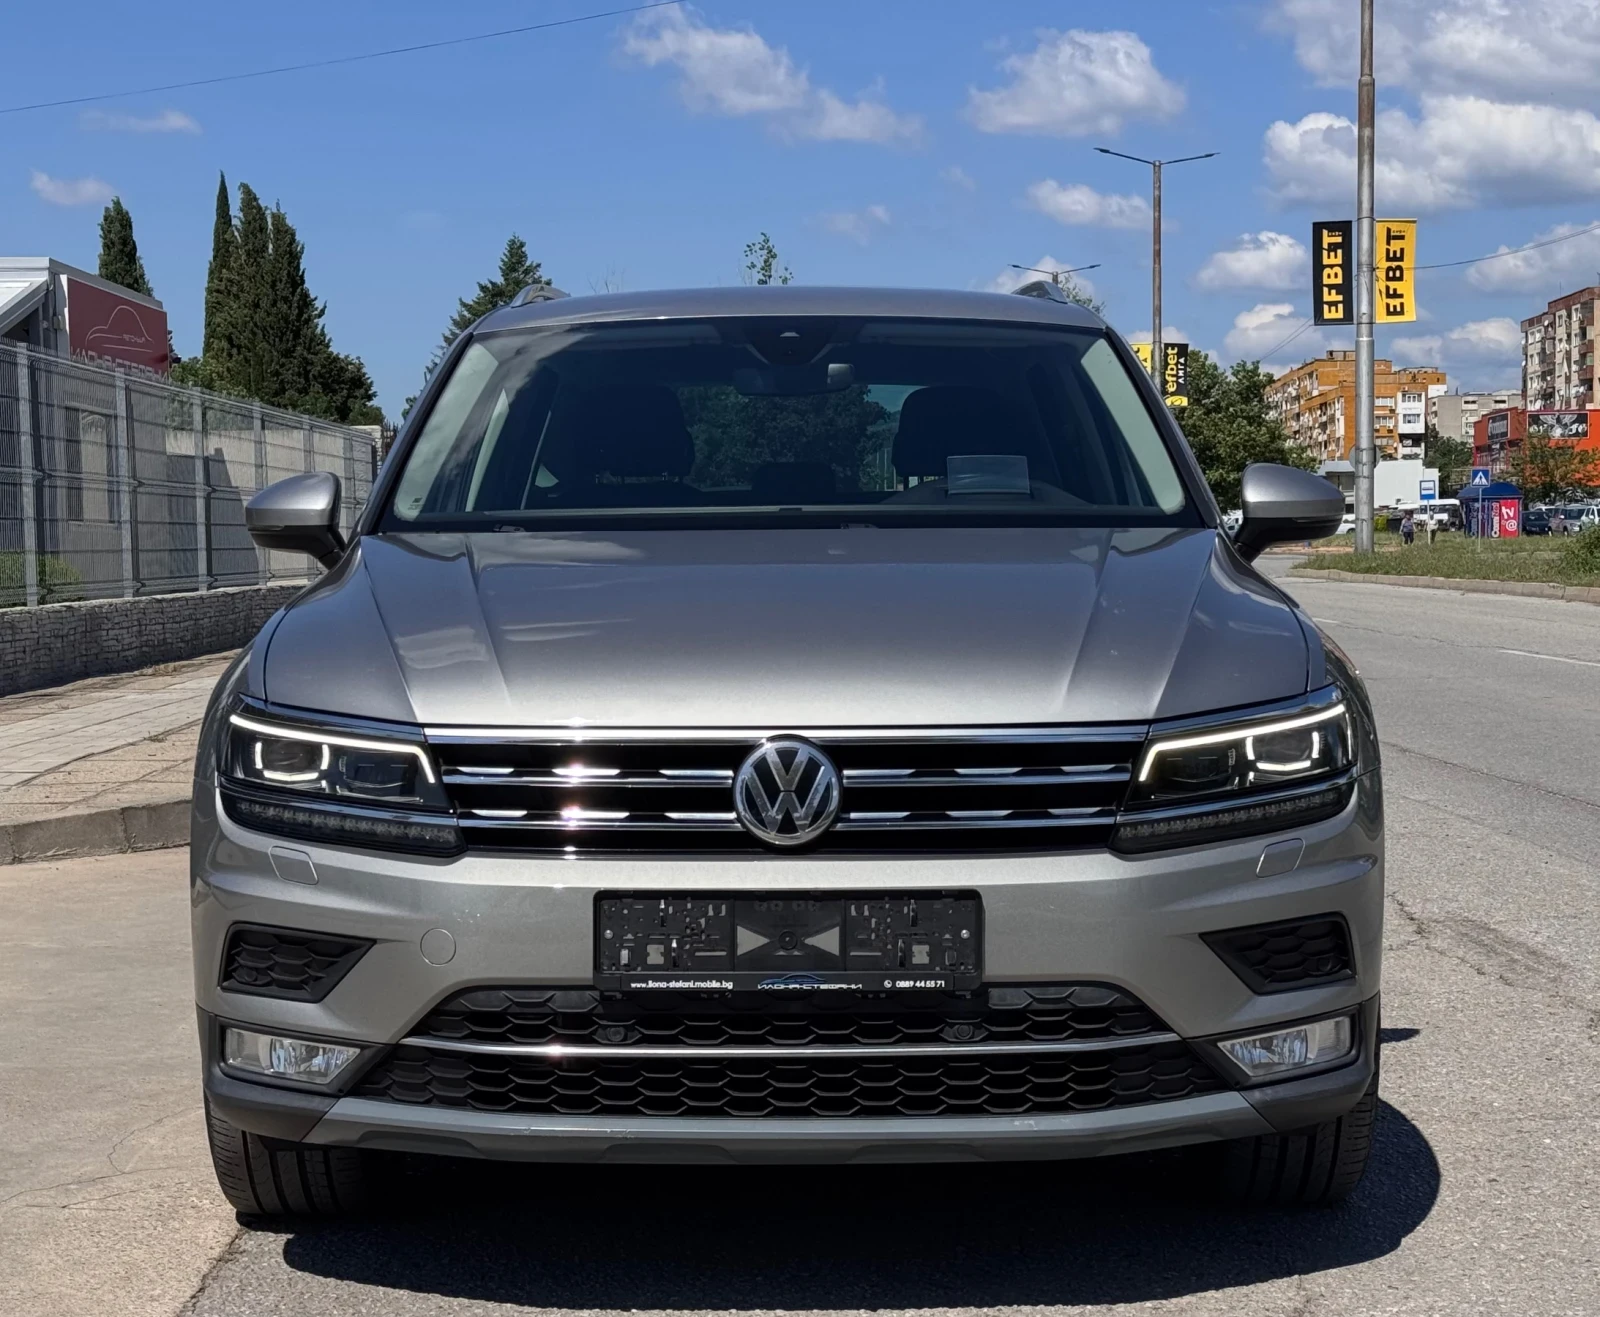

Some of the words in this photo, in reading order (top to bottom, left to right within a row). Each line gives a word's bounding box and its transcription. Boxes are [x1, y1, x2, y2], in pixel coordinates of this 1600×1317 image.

[1322, 228, 1344, 320] EFBET
[1385, 226, 1406, 317] EFBET
[1165, 346, 1178, 393] efbet
[1178, 356, 1186, 384] ЛИГА
[915, 980, 926, 988] 44
[926, 980, 936, 988] 55
[936, 980, 946, 988] 71
